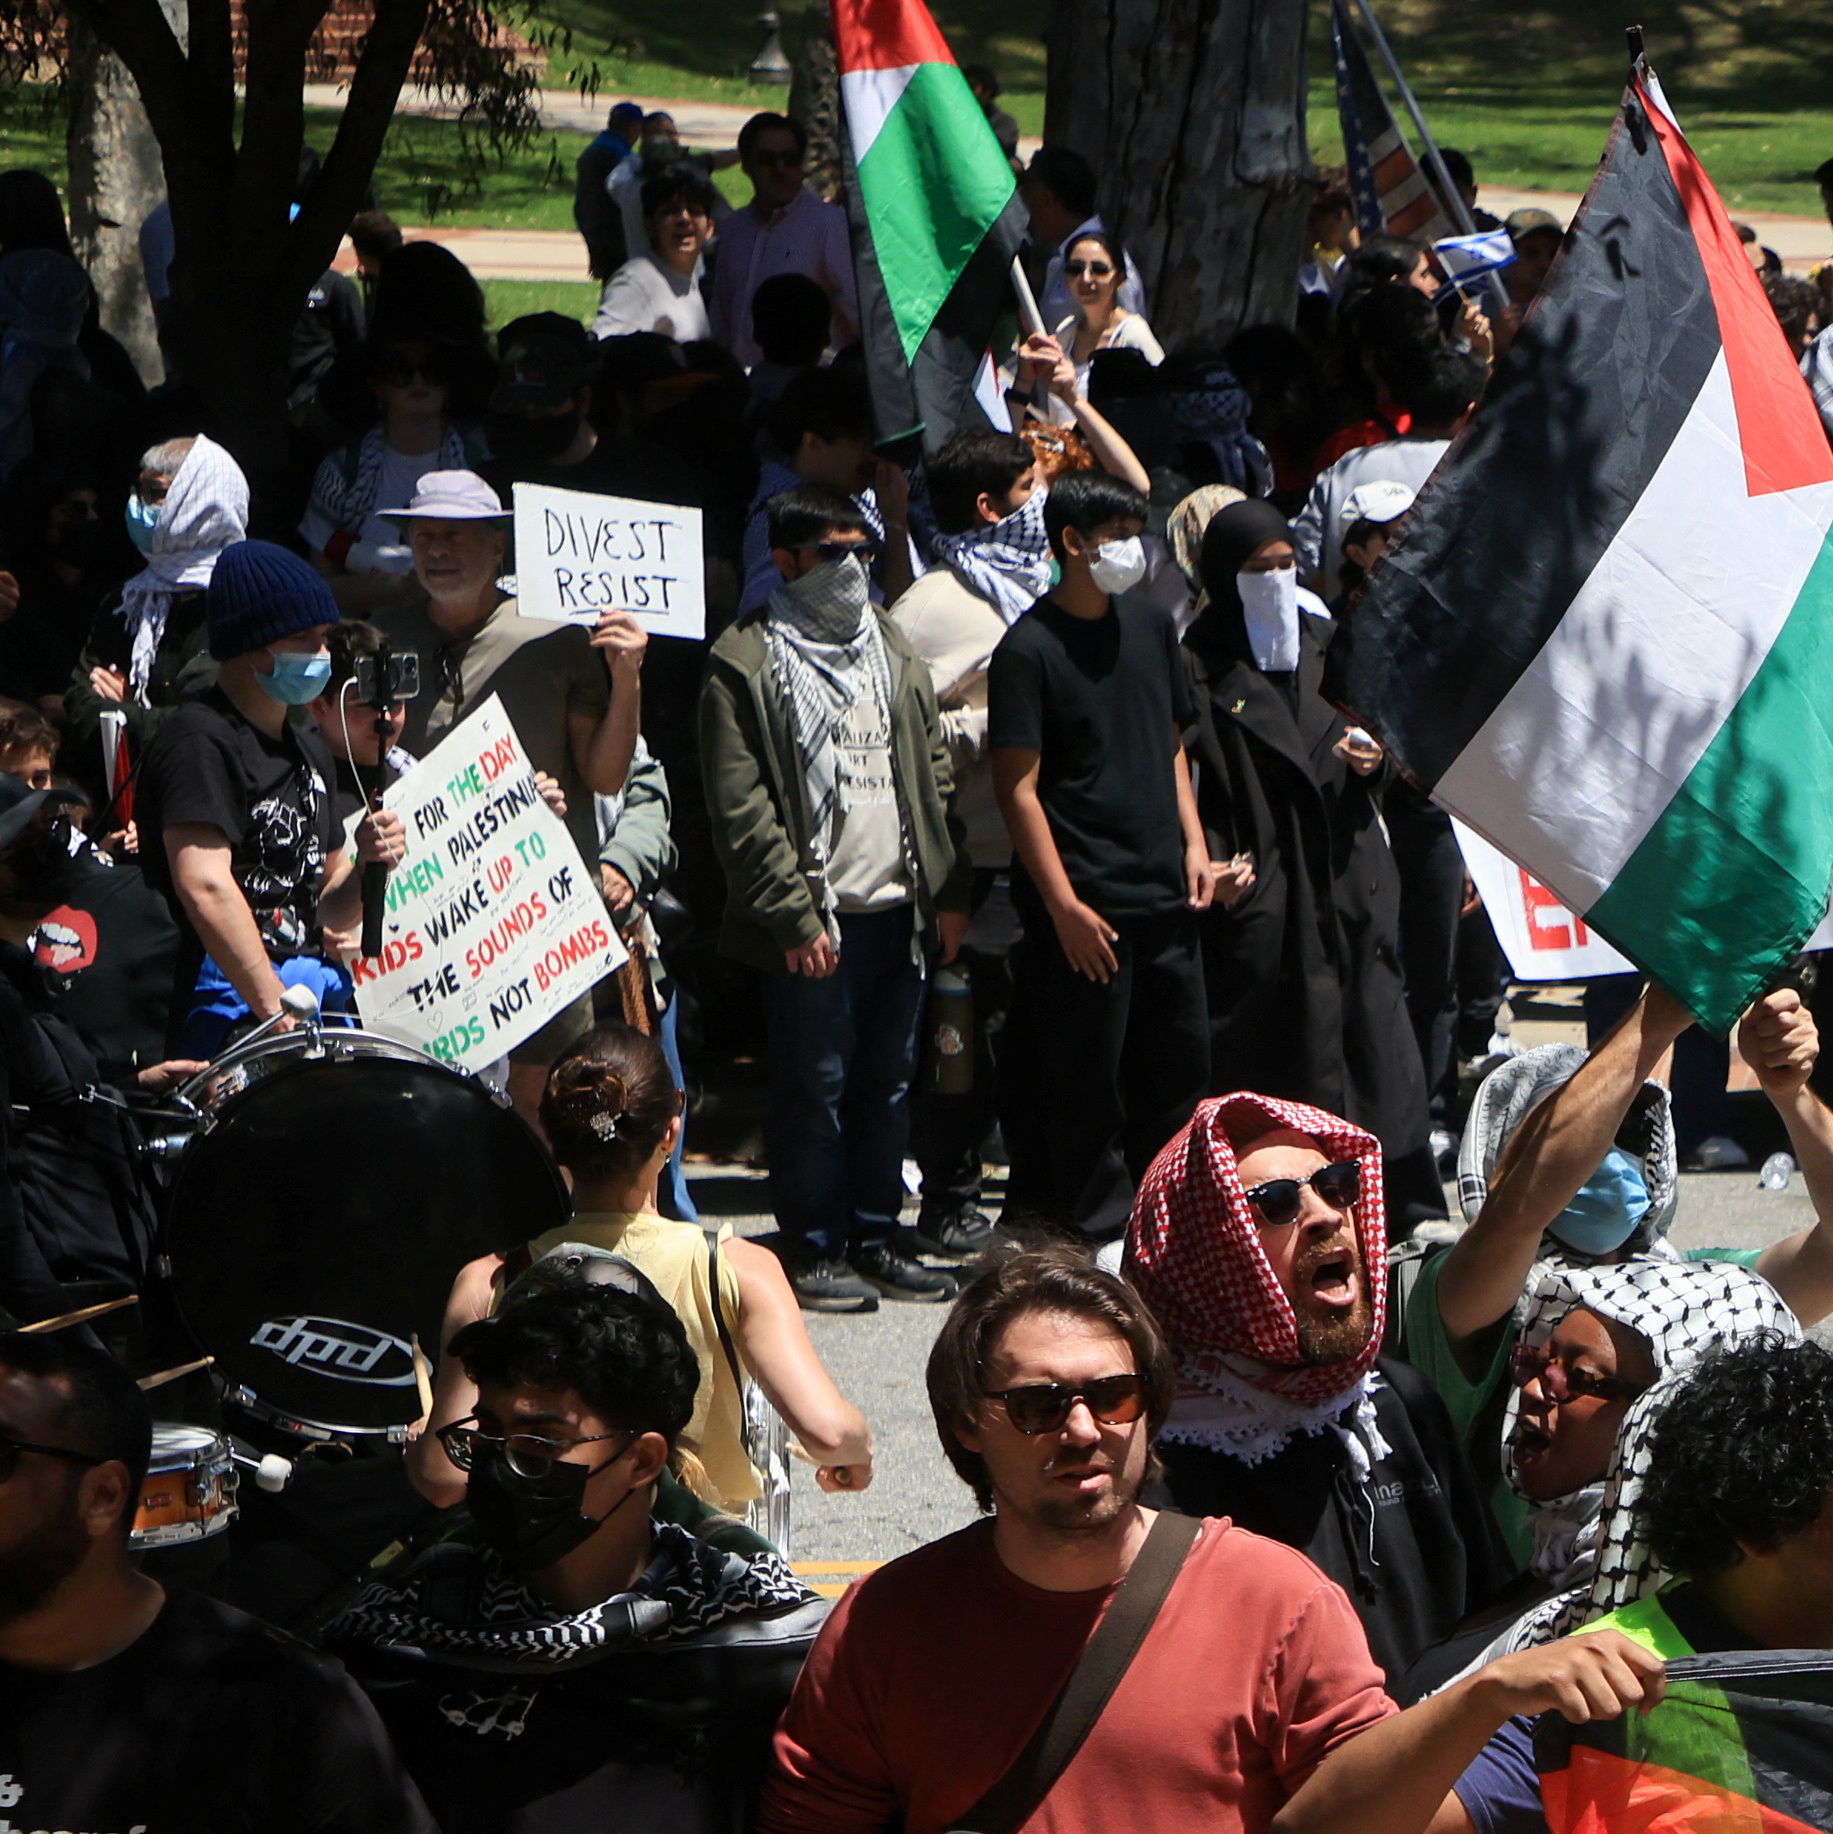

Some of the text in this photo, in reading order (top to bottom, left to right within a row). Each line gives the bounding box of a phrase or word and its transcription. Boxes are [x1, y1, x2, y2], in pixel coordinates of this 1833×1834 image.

[545, 508, 682, 564] DIVEST
[554, 568, 680, 609] RESIST
[414, 734, 518, 841] FOR THE DAY
[351, 931, 423, 987] KIDS
[424, 879, 490, 947] WAKE
[487, 856, 513, 895] UP
[513, 831, 547, 868] TO
[407, 963, 461, 1012] THE
[465, 892, 548, 979] SOUNDS
[549, 866, 574, 907] OF
[423, 1016, 486, 1062] IRDS
[489, 977, 534, 1031] NOT
[533, 920, 610, 993] BOMBS
